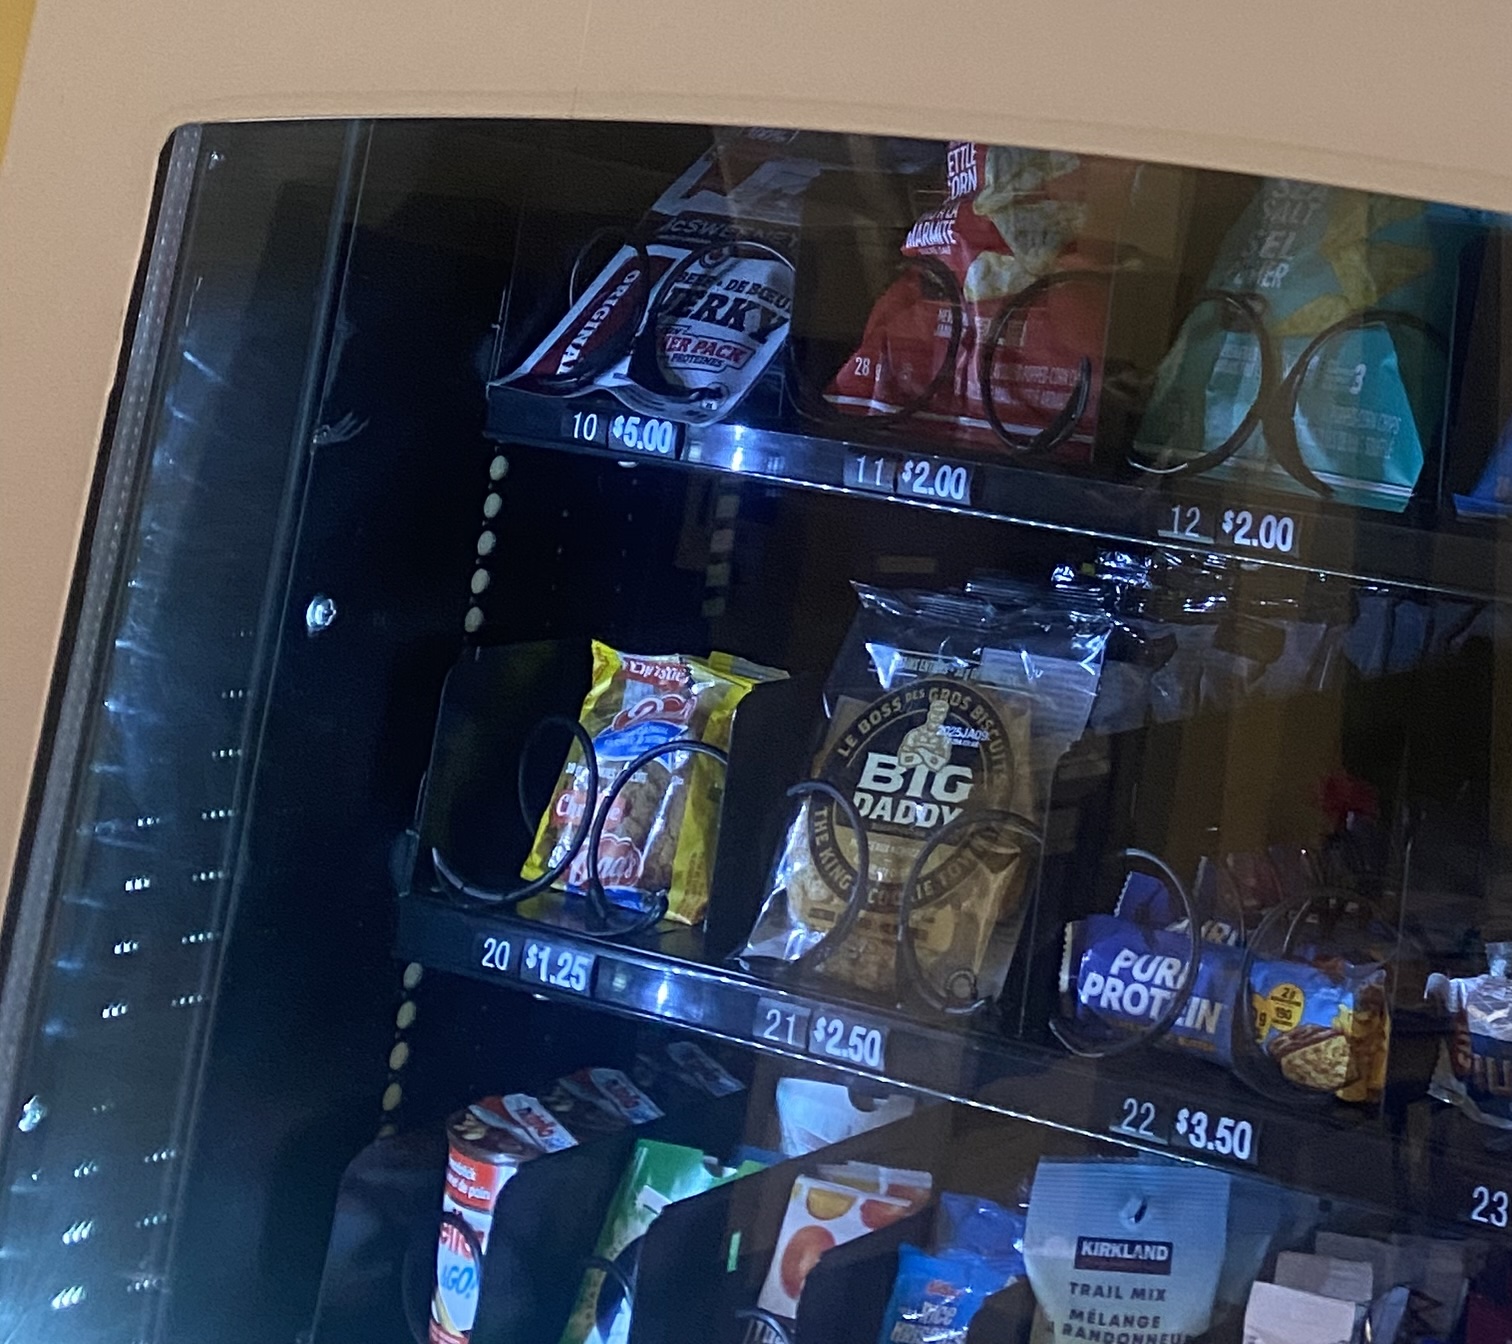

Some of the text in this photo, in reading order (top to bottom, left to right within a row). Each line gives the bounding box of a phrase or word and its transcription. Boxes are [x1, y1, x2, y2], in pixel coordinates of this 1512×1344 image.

[947, 143, 978, 177] ETTLE
[948, 165, 978, 201] ORN
[854, 356, 871, 377] 28
[571, 411, 676, 453] 10 $5.00
[855, 454, 971, 504] 11 $2.00
[1170, 504, 1295, 553] 12 $2.00
[837, 736, 857, 759] LE
[858, 695, 902, 735] BOSS
[904, 688, 926, 703] DES
[928, 685, 973, 712] GROS
[856, 751, 975, 804] BIG
[812, 805, 831, 842] THE
[852, 792, 965, 830] DADDY
[815, 841, 853, 891] KING
[482, 937, 591, 992] 20 $1.25
[761, 1008, 882, 1069] 21 $2.50
[1121, 1097, 1253, 1161] 22 $3.50
[1471, 1185, 1509, 1228] 23
[1081, 1239, 1170, 1262] KIRKLAND
[1069, 1280, 1167, 1302] TRAIL MIX
[1068, 1307, 1162, 1329] MÉLANGE
